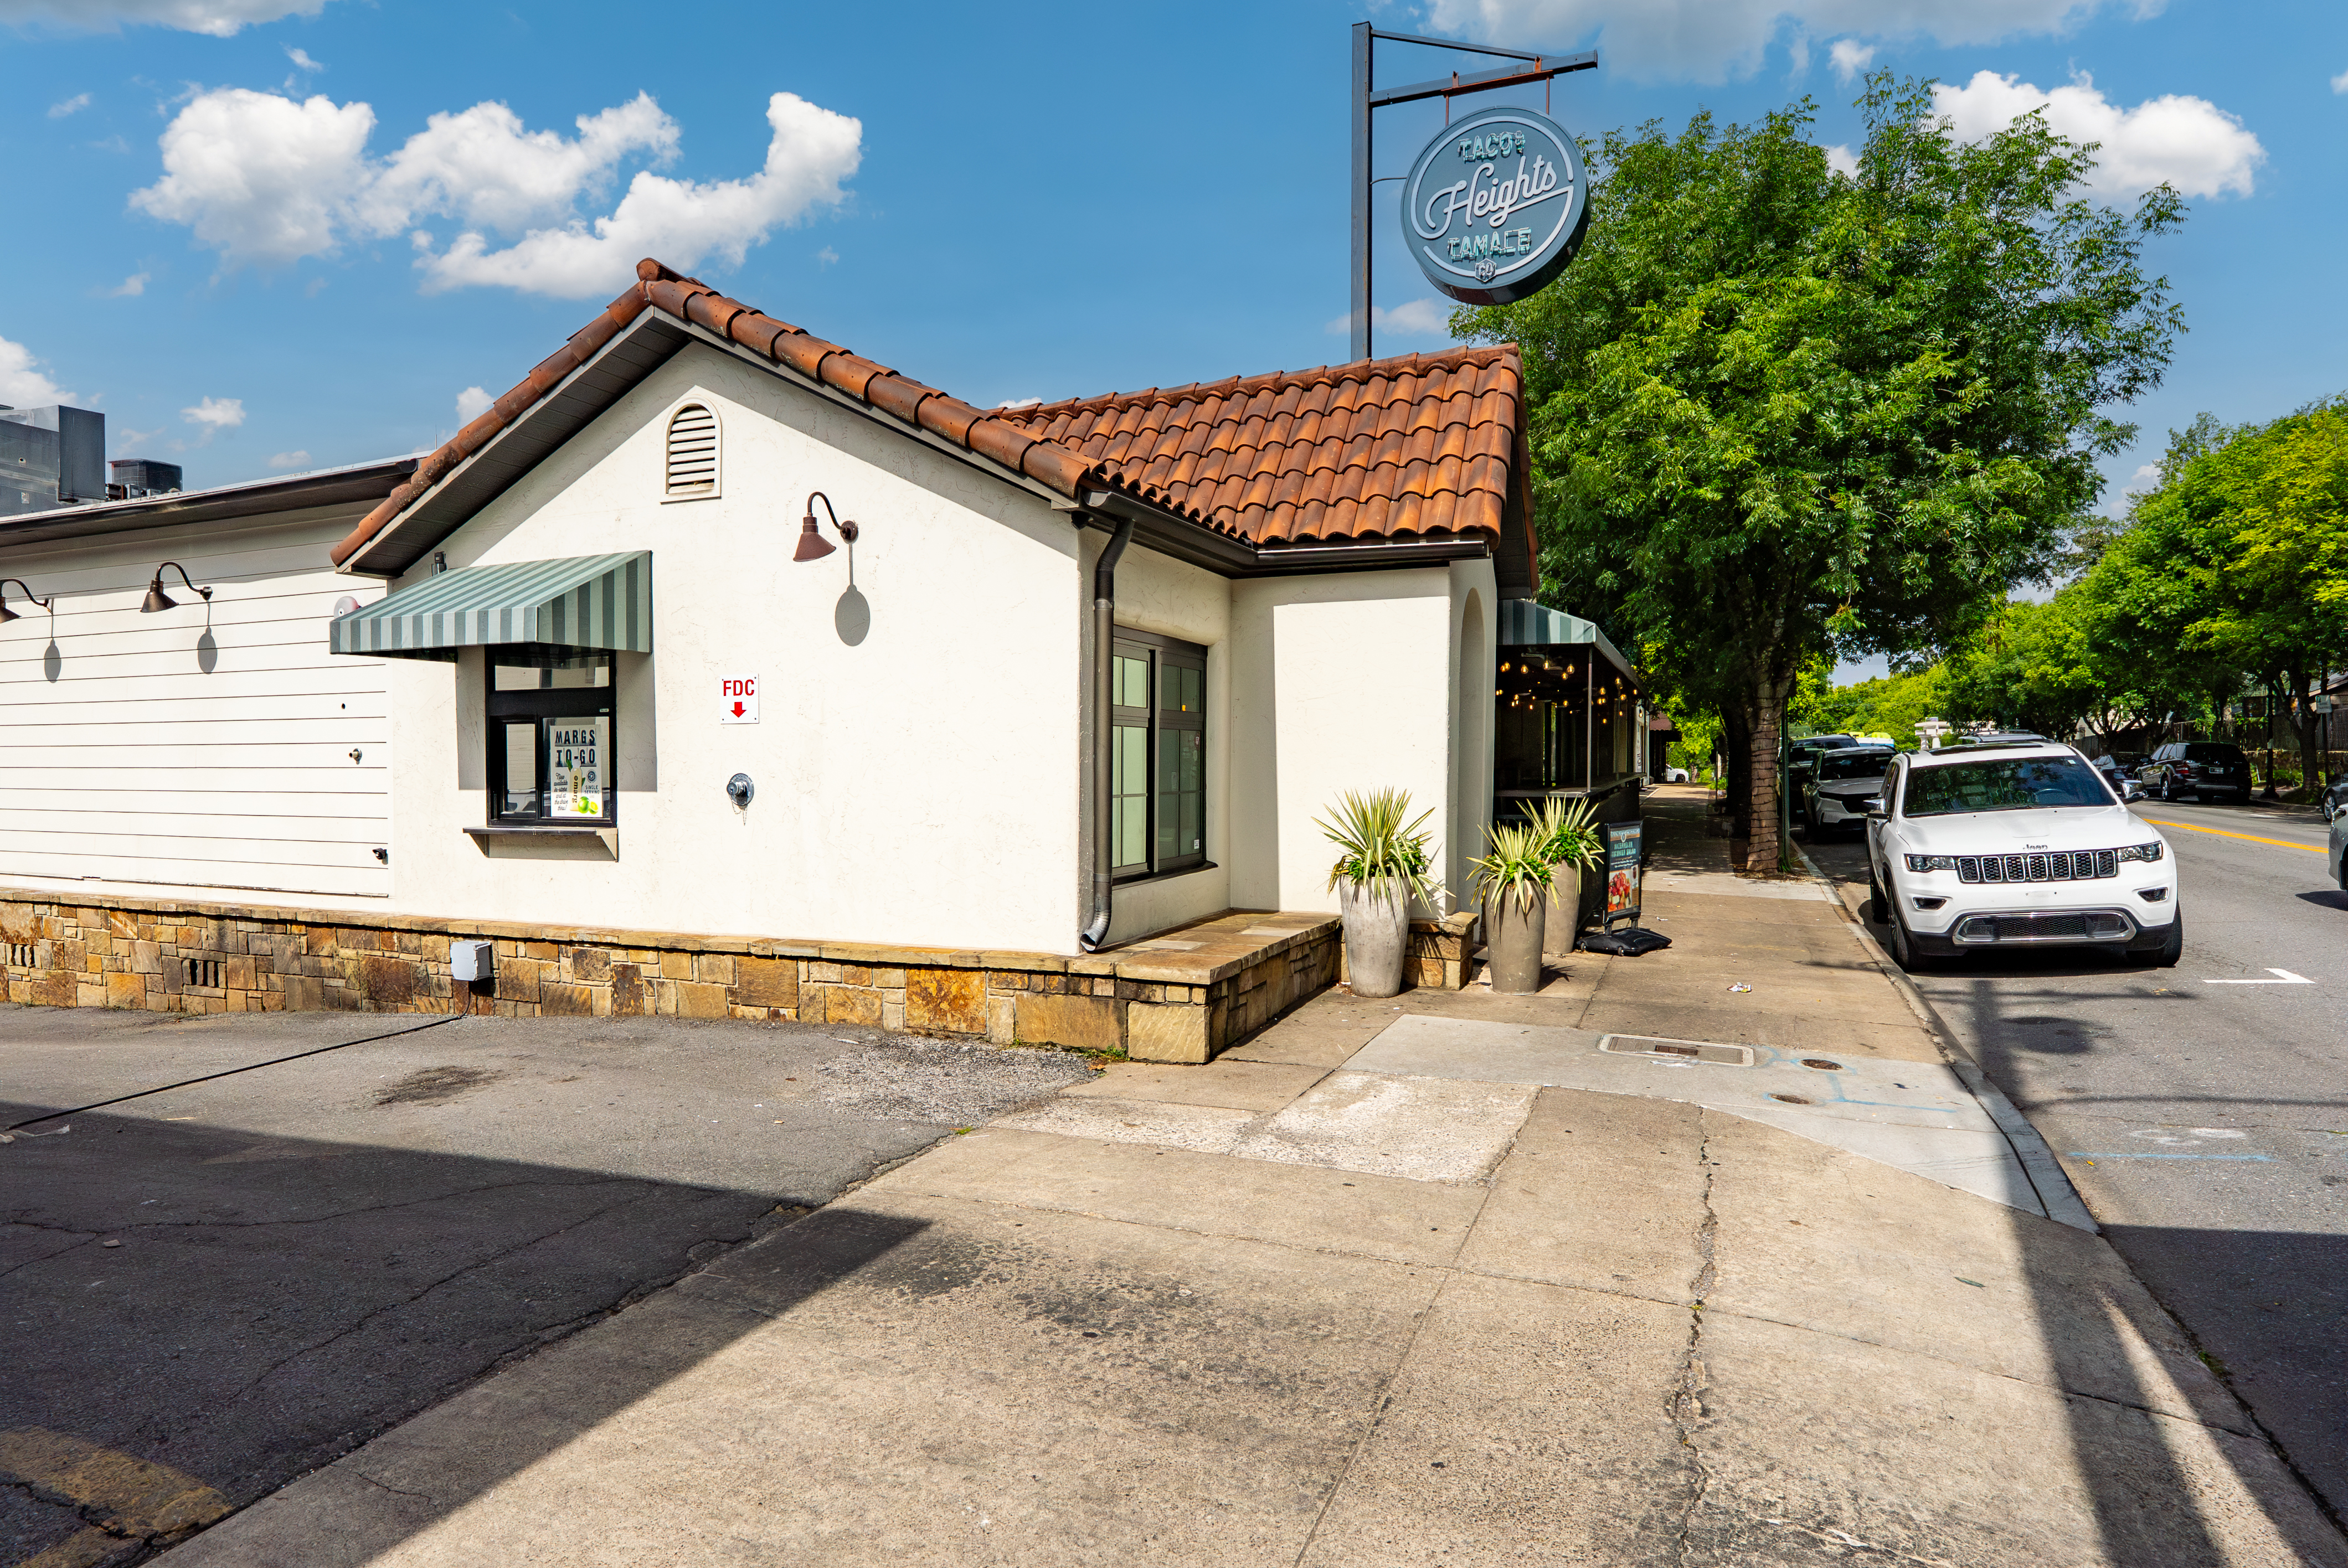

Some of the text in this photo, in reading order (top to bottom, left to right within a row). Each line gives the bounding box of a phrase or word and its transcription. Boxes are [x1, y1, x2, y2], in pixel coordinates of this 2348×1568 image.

[1425, 154, 1557, 239] Heights
[1447, 227, 1532, 260] TAMALE
[723, 679, 754, 696] FDC
[555, 729, 595, 745] MARGS
[556, 749, 595, 766] TO-GO
